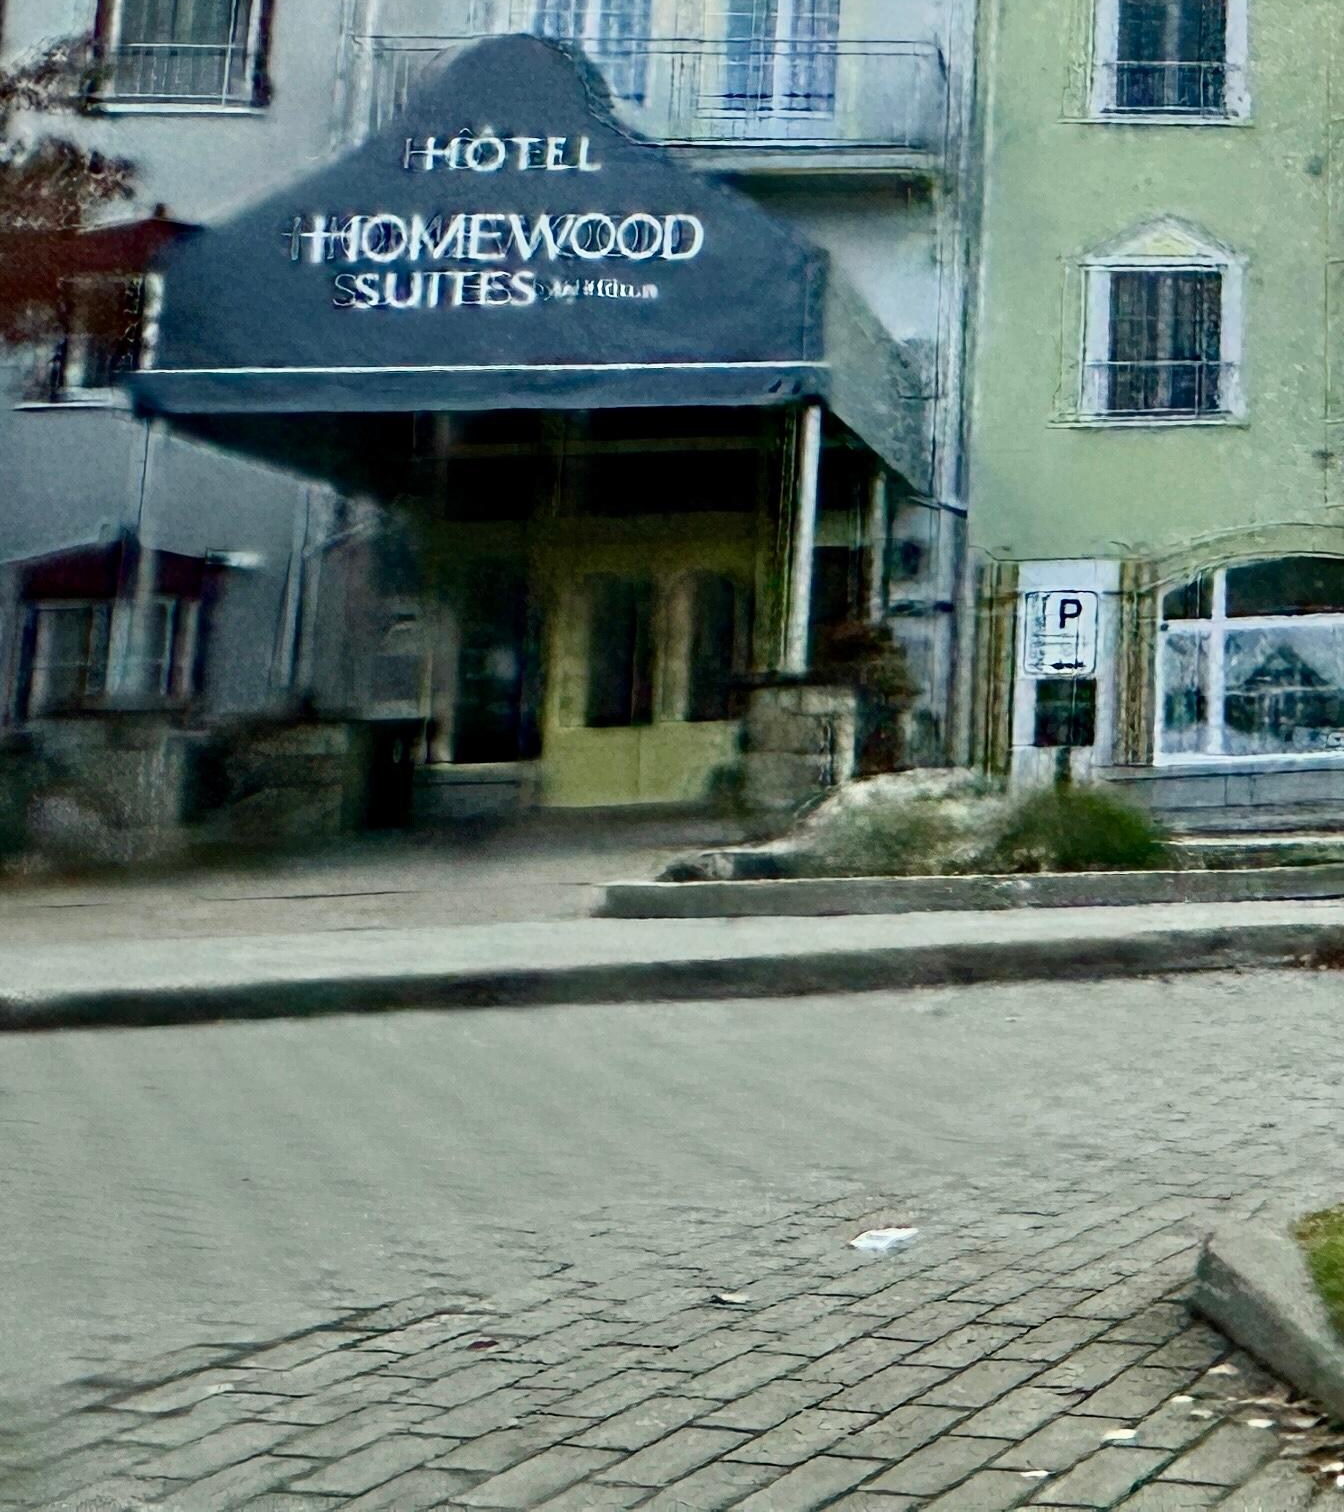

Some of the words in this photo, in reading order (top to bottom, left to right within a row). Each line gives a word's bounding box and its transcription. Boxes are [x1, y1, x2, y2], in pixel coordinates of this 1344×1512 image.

[288, 212, 704, 264] HOMEWOOD
[333, 270, 535, 308] SUITES
[1059, 598, 1082, 629] P
